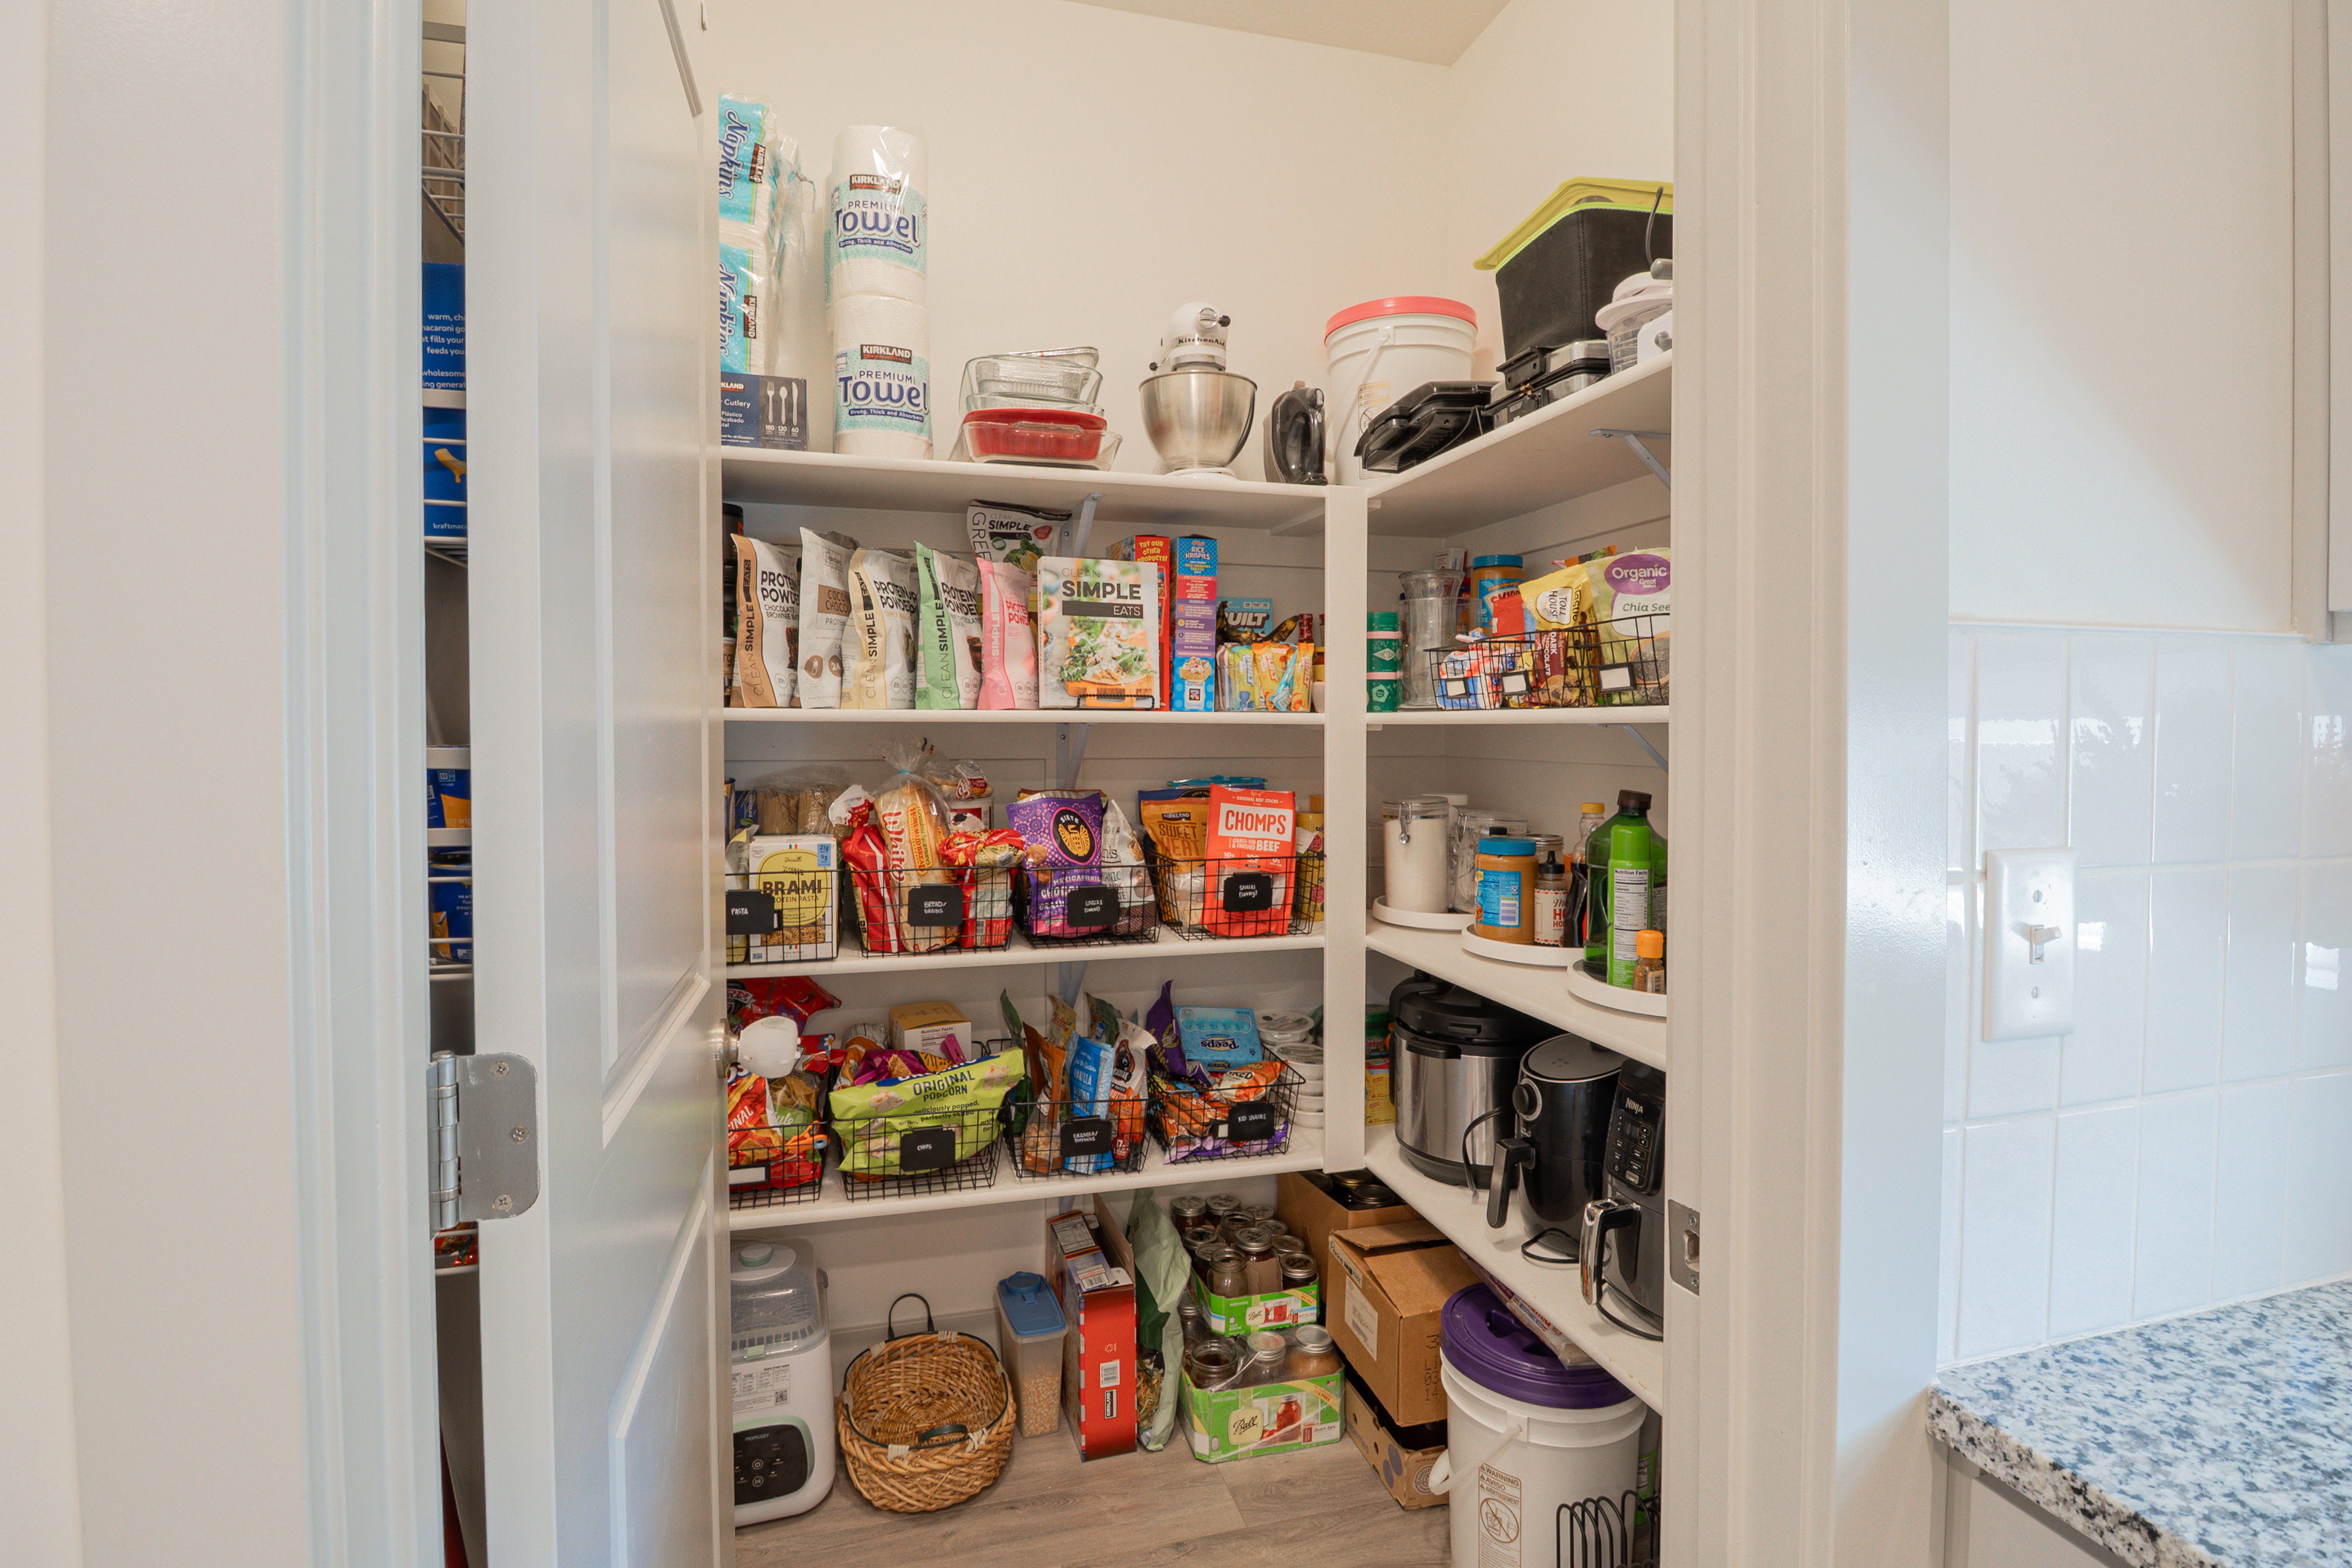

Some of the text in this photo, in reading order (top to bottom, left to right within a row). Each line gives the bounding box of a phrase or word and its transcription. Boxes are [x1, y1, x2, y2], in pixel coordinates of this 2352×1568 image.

[852, 175, 900, 189] KIRKLAND
[836, 208, 918, 243] Towel
[1179, 337, 1224, 346] KitchenAid
[863, 346, 911, 358] KIRKLAND
[859, 371, 912, 383] PREMIUM
[839, 376, 927, 410] Towel
[724, 399, 751, 408] Cutlery
[989, 520, 1032, 531] SIMPLE
[1062, 568, 1100, 578] CLEAN
[1612, 564, 1667, 581] Organic
[1062, 580, 1141, 600] SIMPLE
[764, 604, 795, 614] CHOCOLATE
[1113, 605, 1141, 616] EATS
[1559, 596, 1568, 616] TOLL
[1623, 603, 1648, 611] Chia
[766, 611, 791, 620] BROWNIE
[1225, 612, 1267, 626] UILT
[745, 604, 755, 652] SIMPLE
[865, 613, 878, 657] SIMPLE
[992, 613, 1000, 656] SIMPLE
[935, 602, 953, 699] CLEAN SIMPLE
[746, 653, 764, 696] CLEAN
[866, 659, 878, 698] CLEAN
[1225, 810, 1287, 835] CHOMPS
[1159, 823, 1197, 839] SWEET
[1257, 840, 1280, 852] BEEF
[763, 879, 822, 895] BRAMI
[1200, 1037, 1239, 1050] Peeps
[913, 1071, 975, 1096] ORIGINAL
[923, 1085, 967, 1102] POPCORN
[952, 1100, 980, 1111] popped,
[1625, 1097, 1644, 1114] NINJA
[1233, 1415, 1258, 1435] Ball
[1486, 1466, 1519, 1487] WARNING
[1486, 1477, 1506, 1491] AVISO
[1486, 1486, 1519, 1505] AVERTISSEMENT
